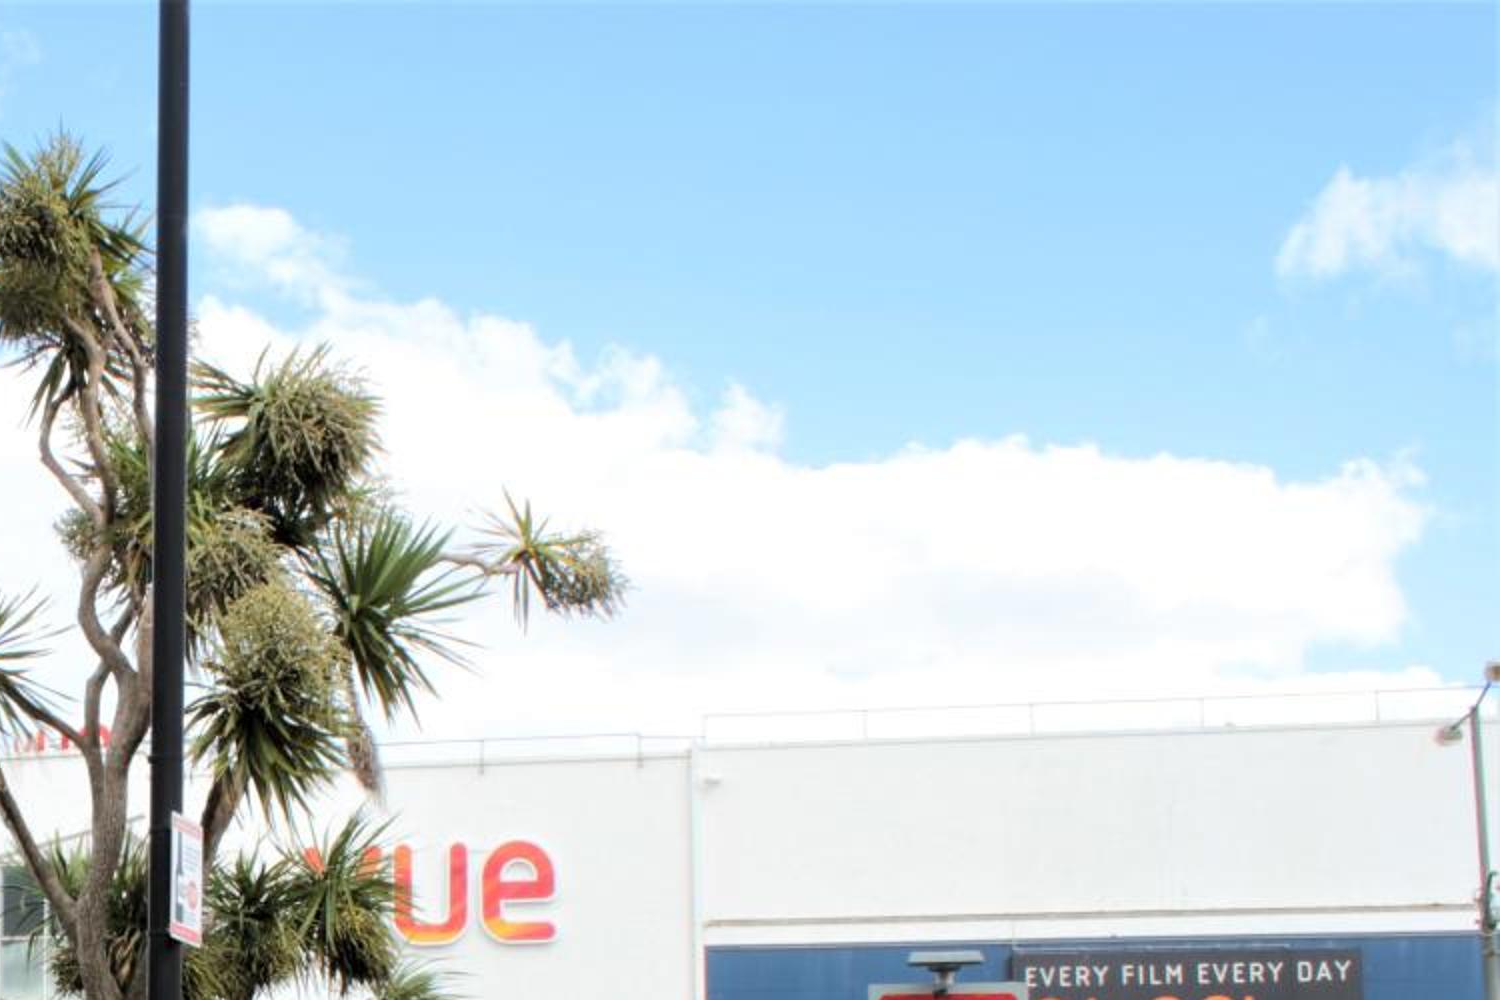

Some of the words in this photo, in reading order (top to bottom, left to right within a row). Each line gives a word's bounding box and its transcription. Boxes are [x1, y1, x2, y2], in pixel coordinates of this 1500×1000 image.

[1025, 965, 1109, 988] EVERY
[1121, 963, 1183, 986] FILM
[1197, 961, 1285, 985] EVERY
[1297, 959, 1352, 983] DAY
